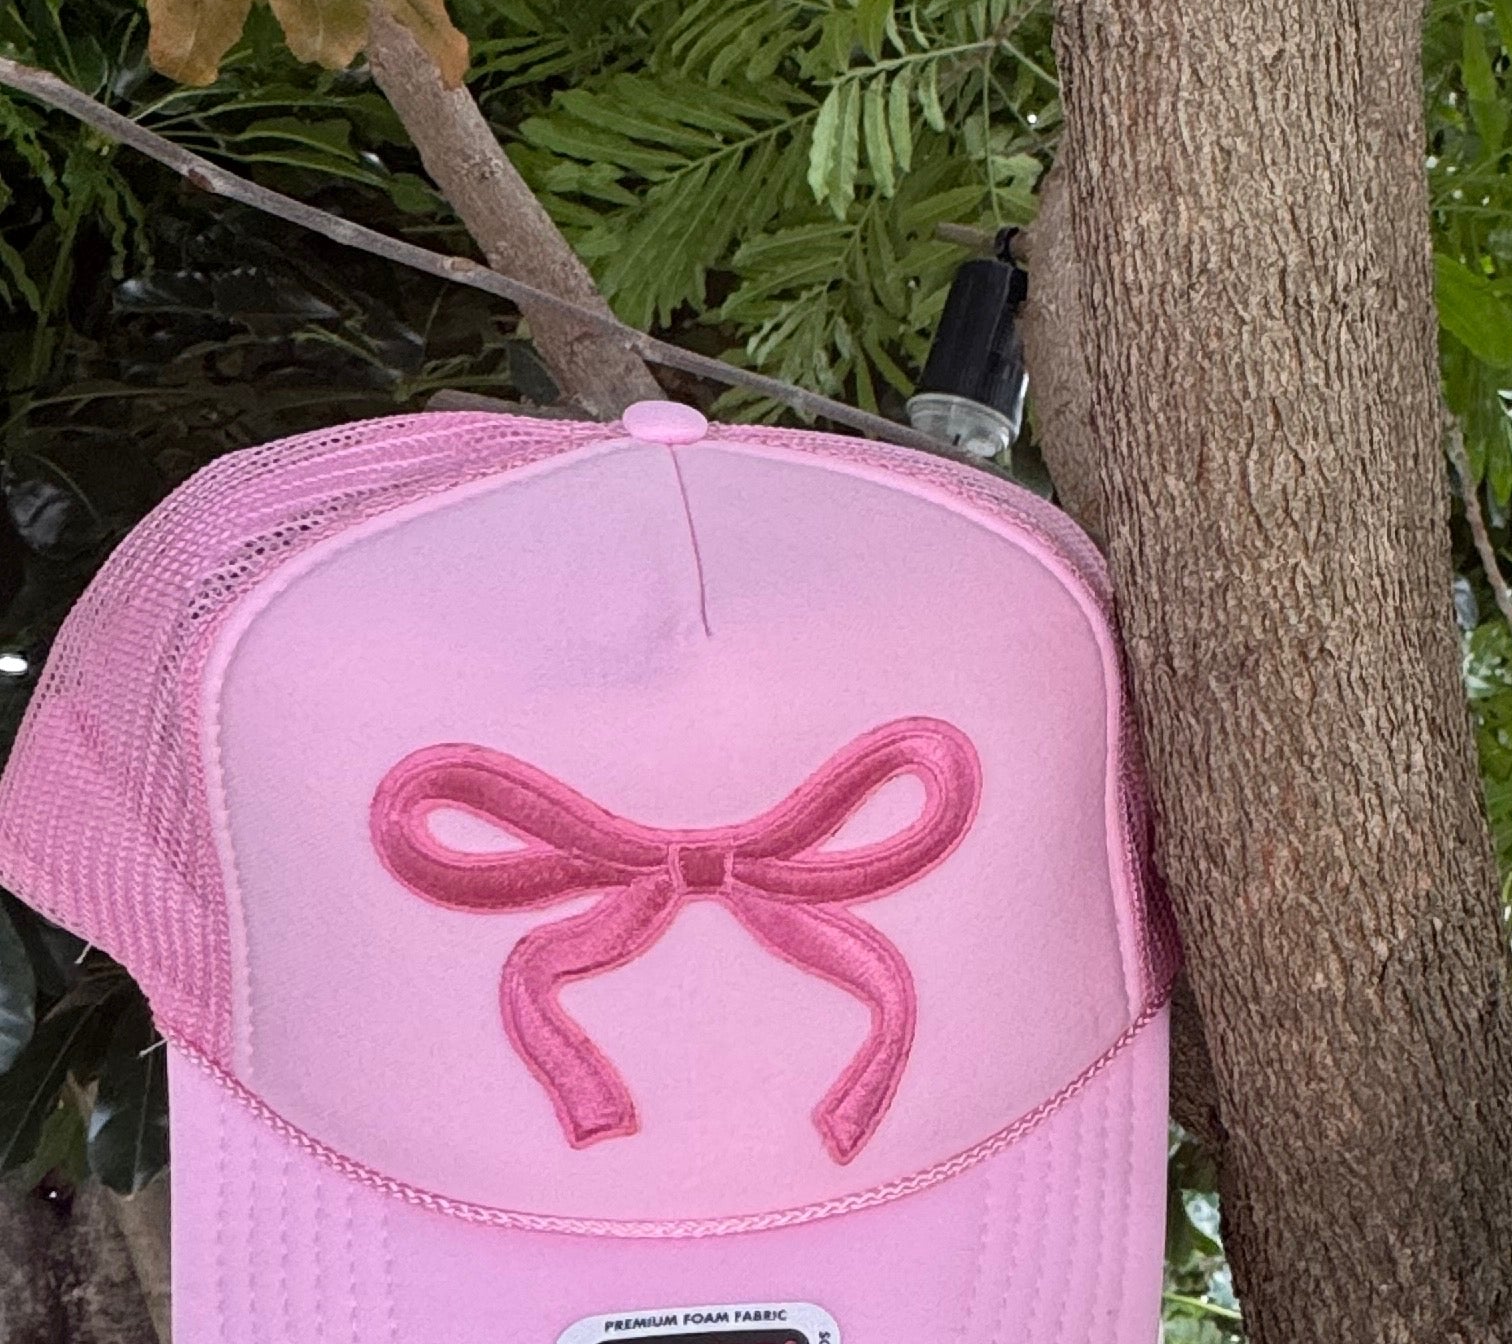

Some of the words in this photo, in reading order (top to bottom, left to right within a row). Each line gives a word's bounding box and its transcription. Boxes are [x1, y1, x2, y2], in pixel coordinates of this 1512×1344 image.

[604, 1315, 678, 1332] PREMIUM
[683, 1312, 729, 1325] FOAM
[734, 1309, 787, 1322] FABRIC
